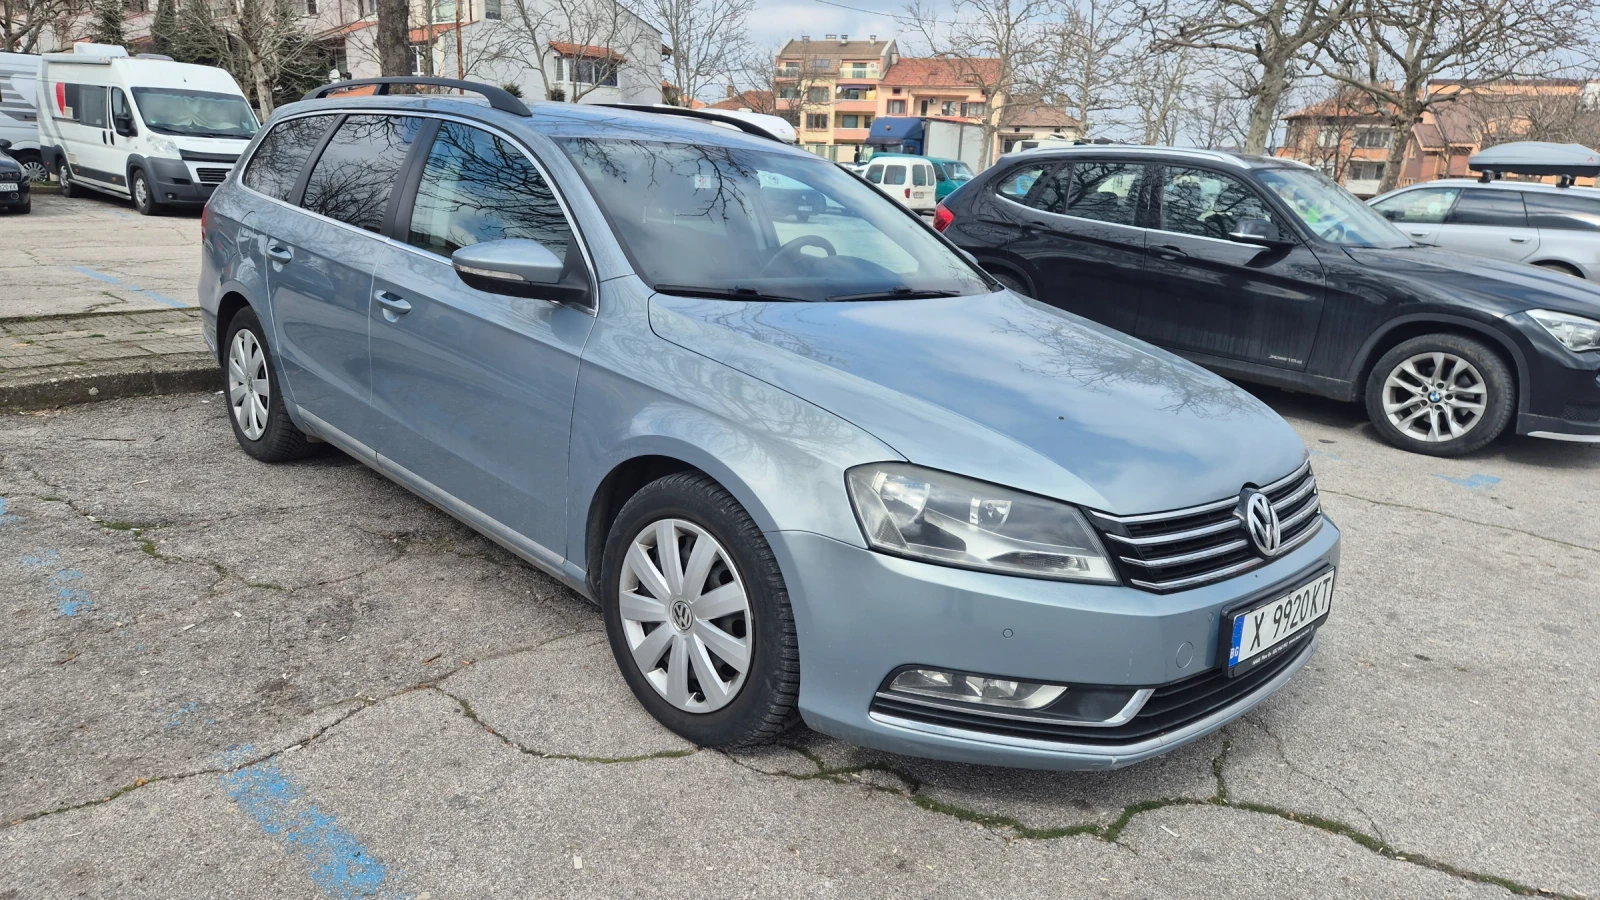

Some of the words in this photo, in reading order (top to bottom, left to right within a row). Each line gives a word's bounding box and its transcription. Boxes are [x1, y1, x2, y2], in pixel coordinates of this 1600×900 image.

[1249, 495, 1280, 554] VW
[673, 602, 692, 629] VW
[1250, 611, 1265, 652] X
[1230, 646, 1240, 659] BG
